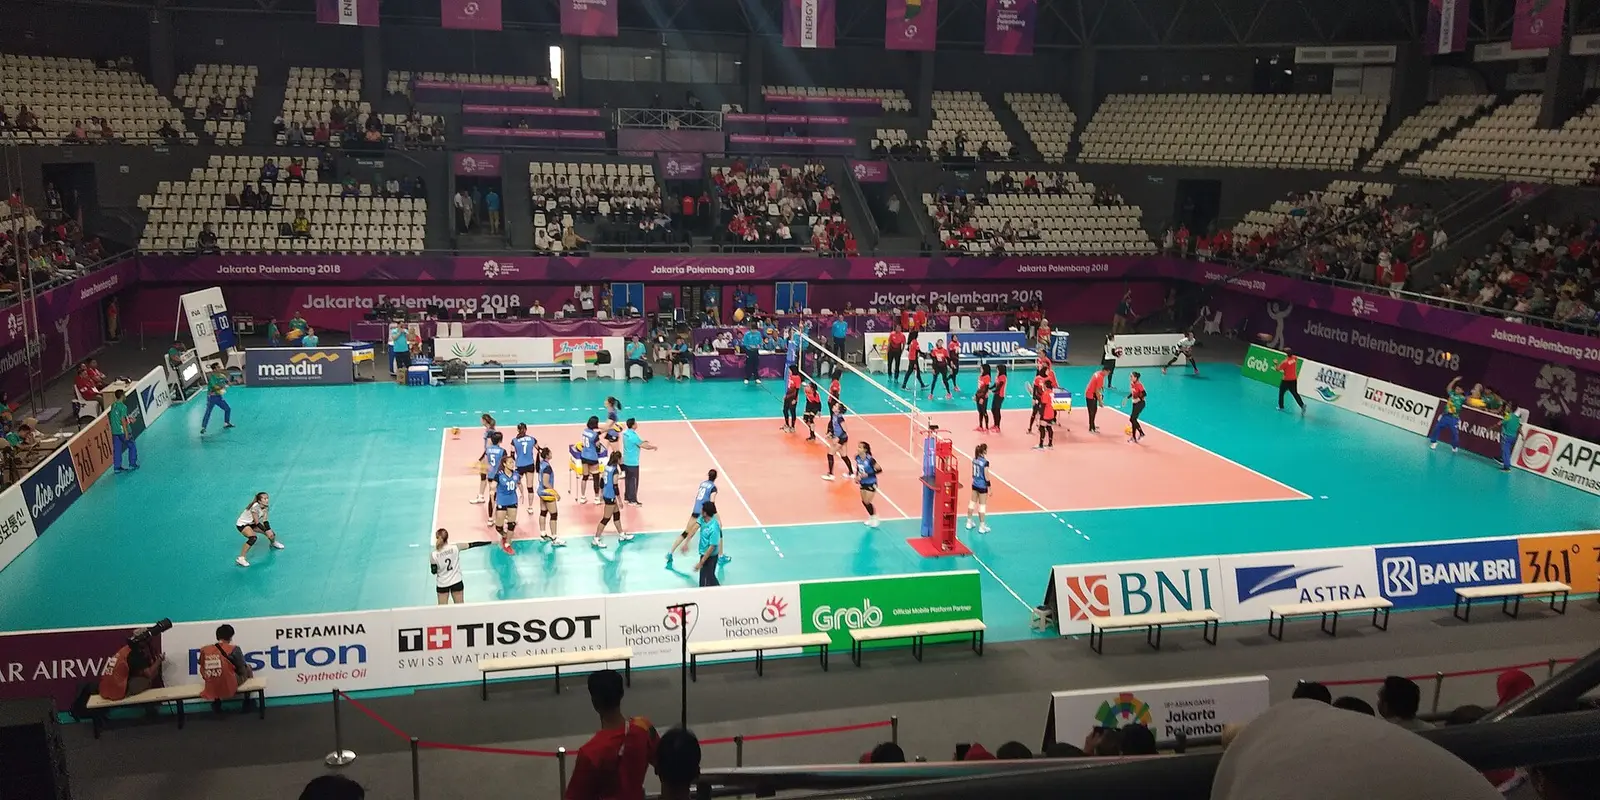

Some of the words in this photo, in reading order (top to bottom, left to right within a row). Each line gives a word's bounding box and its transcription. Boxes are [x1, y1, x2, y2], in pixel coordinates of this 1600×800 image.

[216, 264, 257, 274] Jakarta
[259, 264, 316, 276] Palembang
[317, 265, 341, 274] 2018
[651, 265, 685, 275] Jakarta
[686, 265, 734, 276] Palembang
[735, 265, 755, 274] 2018
[1017, 264, 1047, 273] Jakarta
[1049, 264, 1091, 274] Palembang
[1091, 264, 1109, 272] 2018
[302, 294, 374, 309] Jakarta
[480, 294, 520, 309] 2018
[869, 291, 925, 306] Jakarta
[1303, 319, 1349, 344] Jakarta
[1350, 329, 1424, 366] Palembang
[1491, 328, 1526, 345] Jakarta
[1527, 336, 1583, 360] Palembang
[1247, 356, 1269, 372] Grab
[1384, 392, 1434, 418] TISSOT
[521, 441, 528, 454] 7
[489, 454, 496, 466] 5
[506, 480, 515, 490] 10
[444, 558, 453, 571] 2
[1419, 561, 1480, 586] BANK
[1483, 558, 1516, 581] BRI
[1118, 568, 1212, 616] BNI
[1299, 583, 1366, 604] ASTRA
[812, 598, 883, 631] Grab
[619, 625, 660, 636] Telkom
[720, 618, 759, 628] Telkom
[275, 624, 366, 640] PERTAMINA
[457, 615, 600, 647] TISSOT
[725, 625, 778, 638] Indonesia
[624, 634, 681, 647] Indonesia
[398, 656, 444, 669] SWISS
[0, 667, 24, 683] AR
[296, 672, 345, 683] Synthetic
[351, 670, 367, 680] Oil
[1165, 708, 1216, 723] Jakarta
